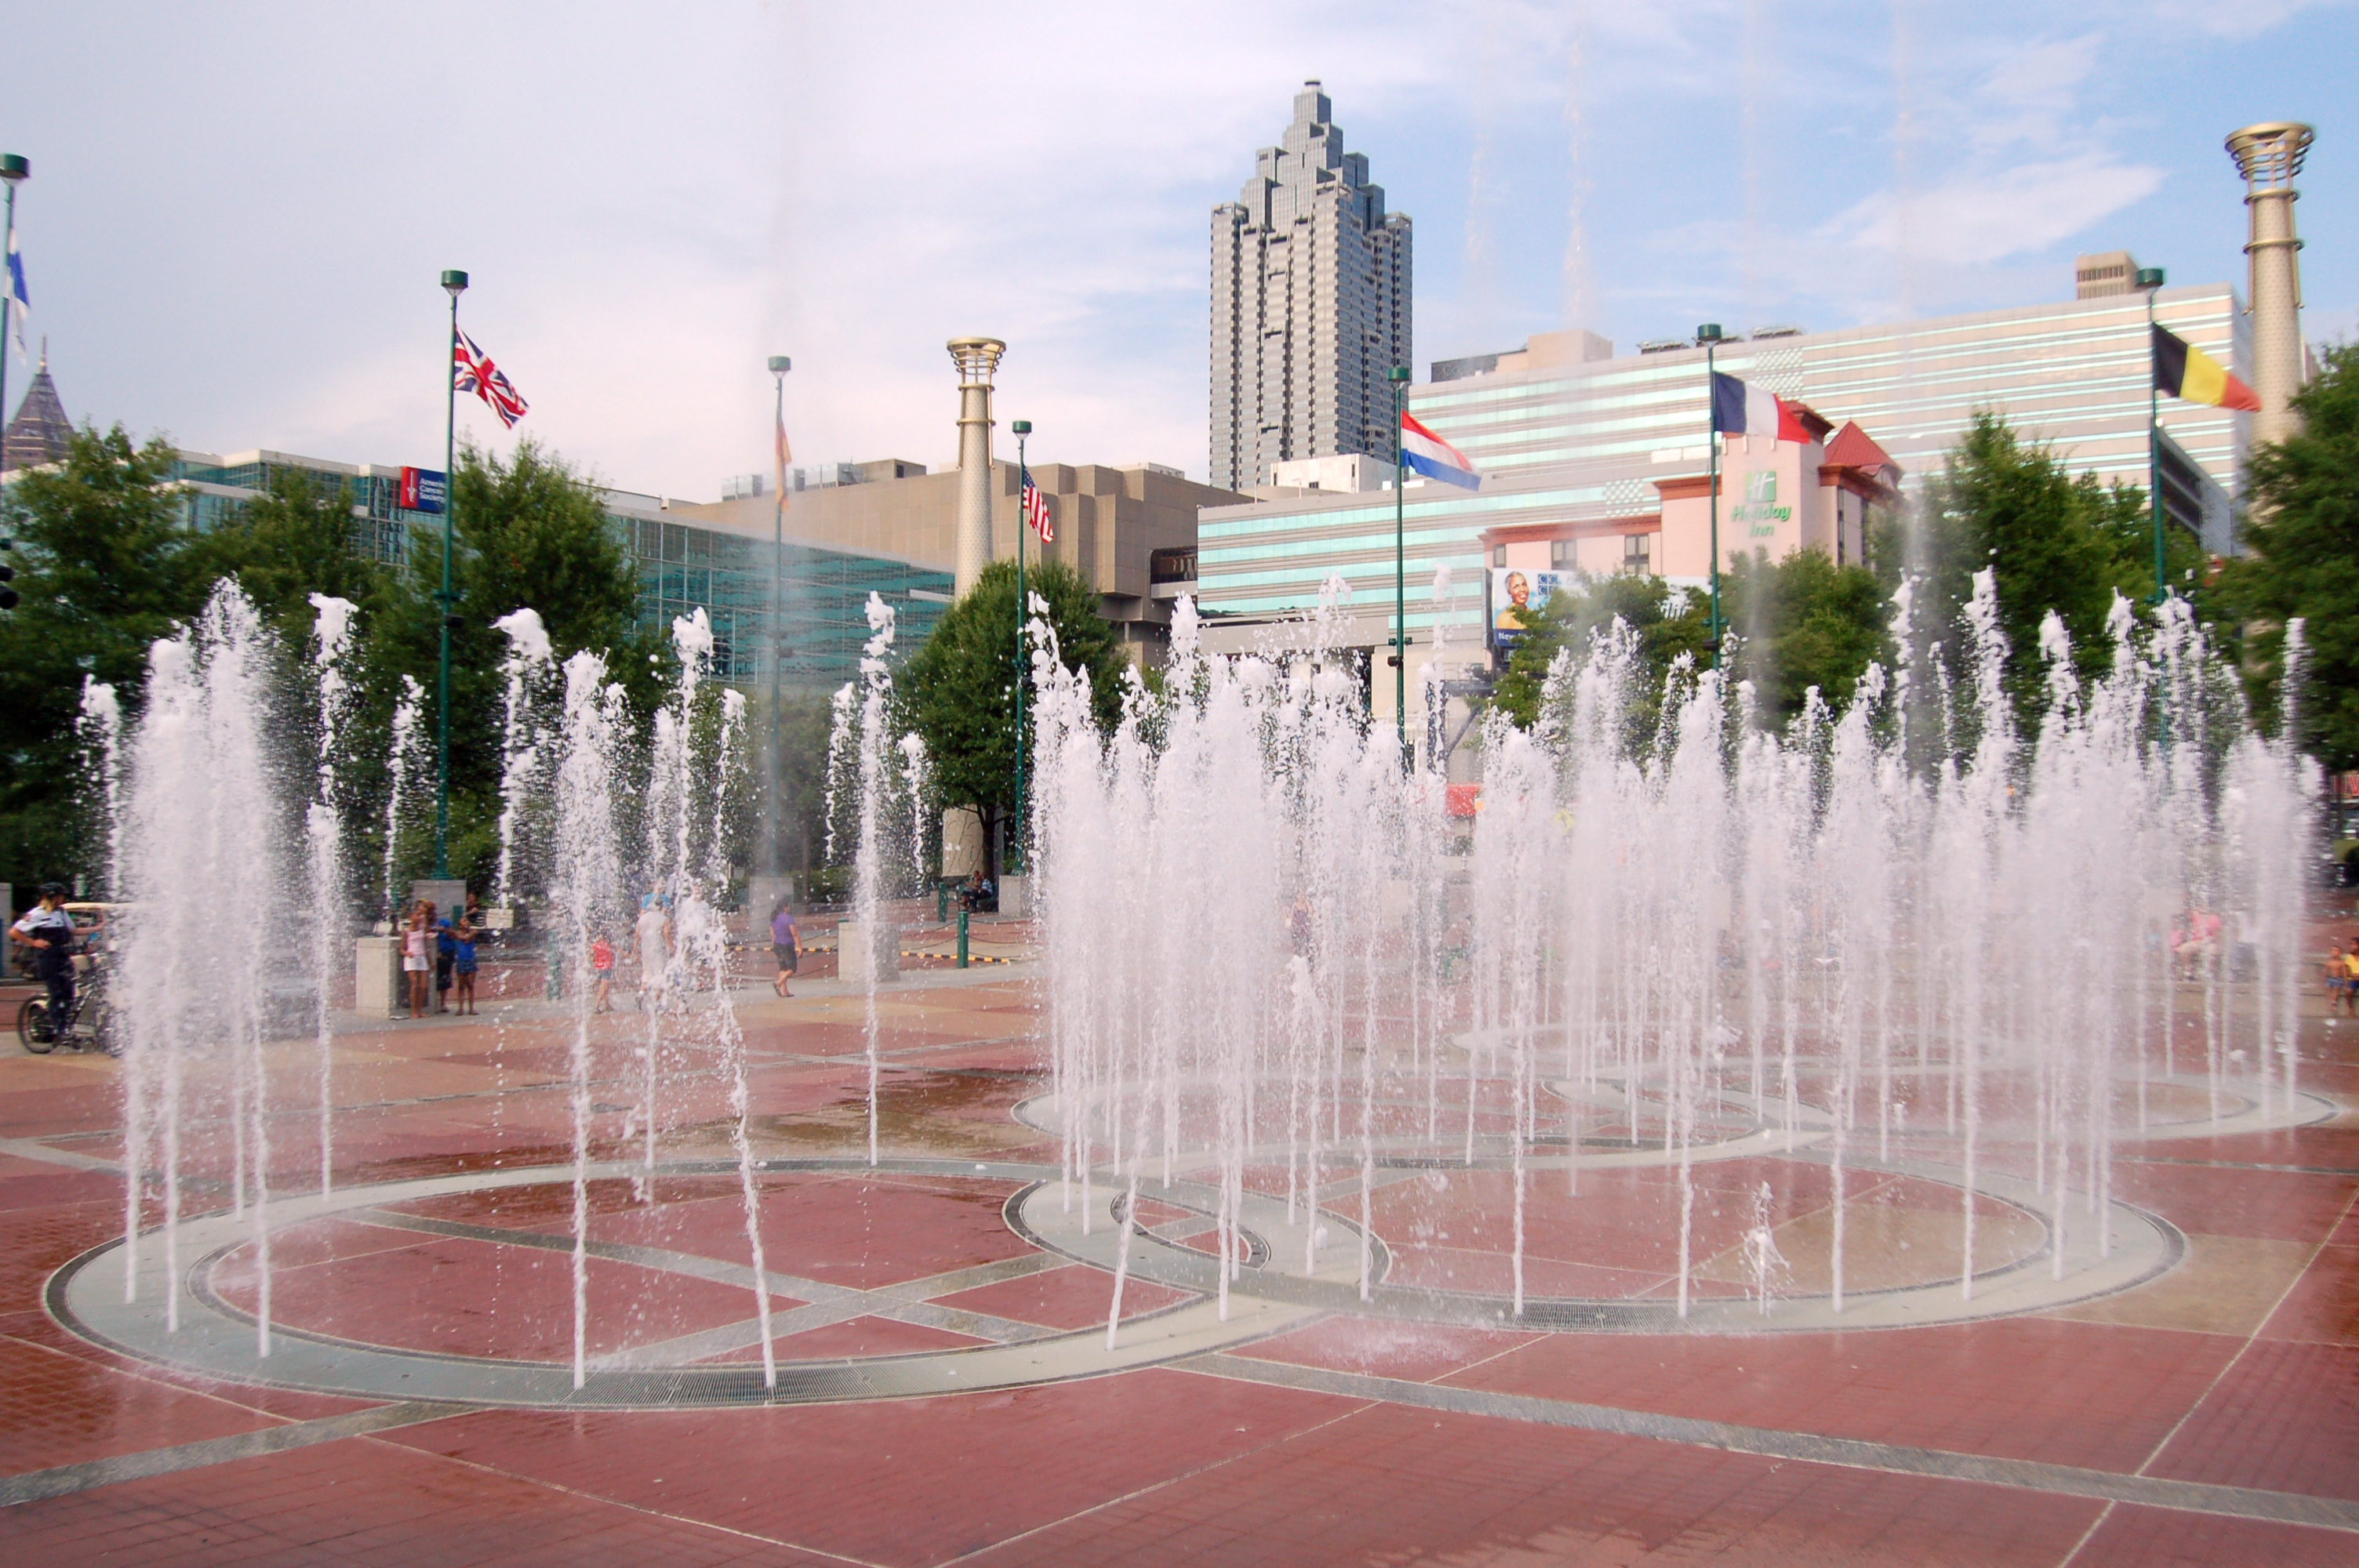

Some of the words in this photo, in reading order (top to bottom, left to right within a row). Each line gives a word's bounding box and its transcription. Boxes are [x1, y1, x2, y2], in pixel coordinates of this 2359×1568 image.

[420, 477, 446, 489] Americ
[1732, 503, 1792, 522] Holiday
[1749, 521, 1775, 538] Inn
